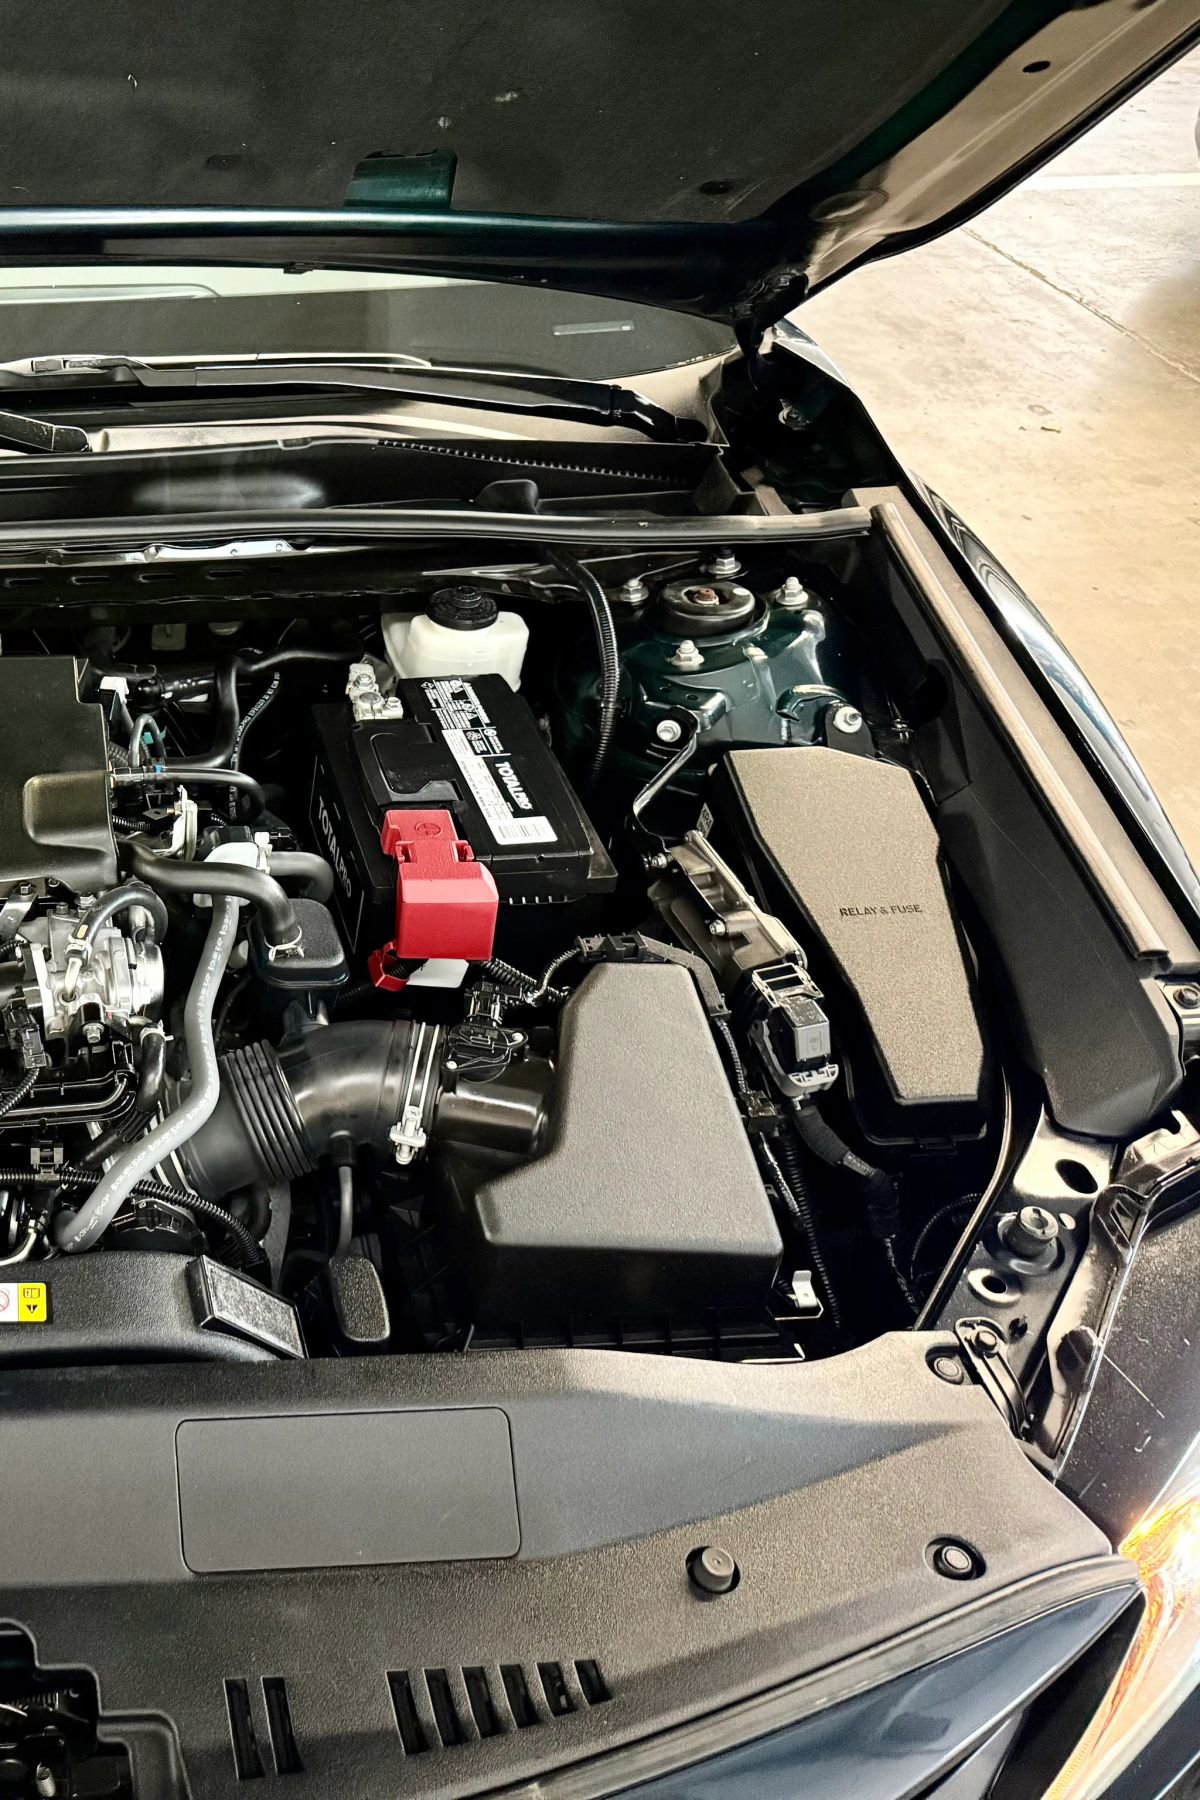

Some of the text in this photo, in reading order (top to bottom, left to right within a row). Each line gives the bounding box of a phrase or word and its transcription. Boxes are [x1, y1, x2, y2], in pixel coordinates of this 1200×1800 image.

[495, 762, 532, 810] TOTALPRO
[318, 796, 351, 897] TOTALPRO
[839, 904, 923, 917] RELAY & FUSE
